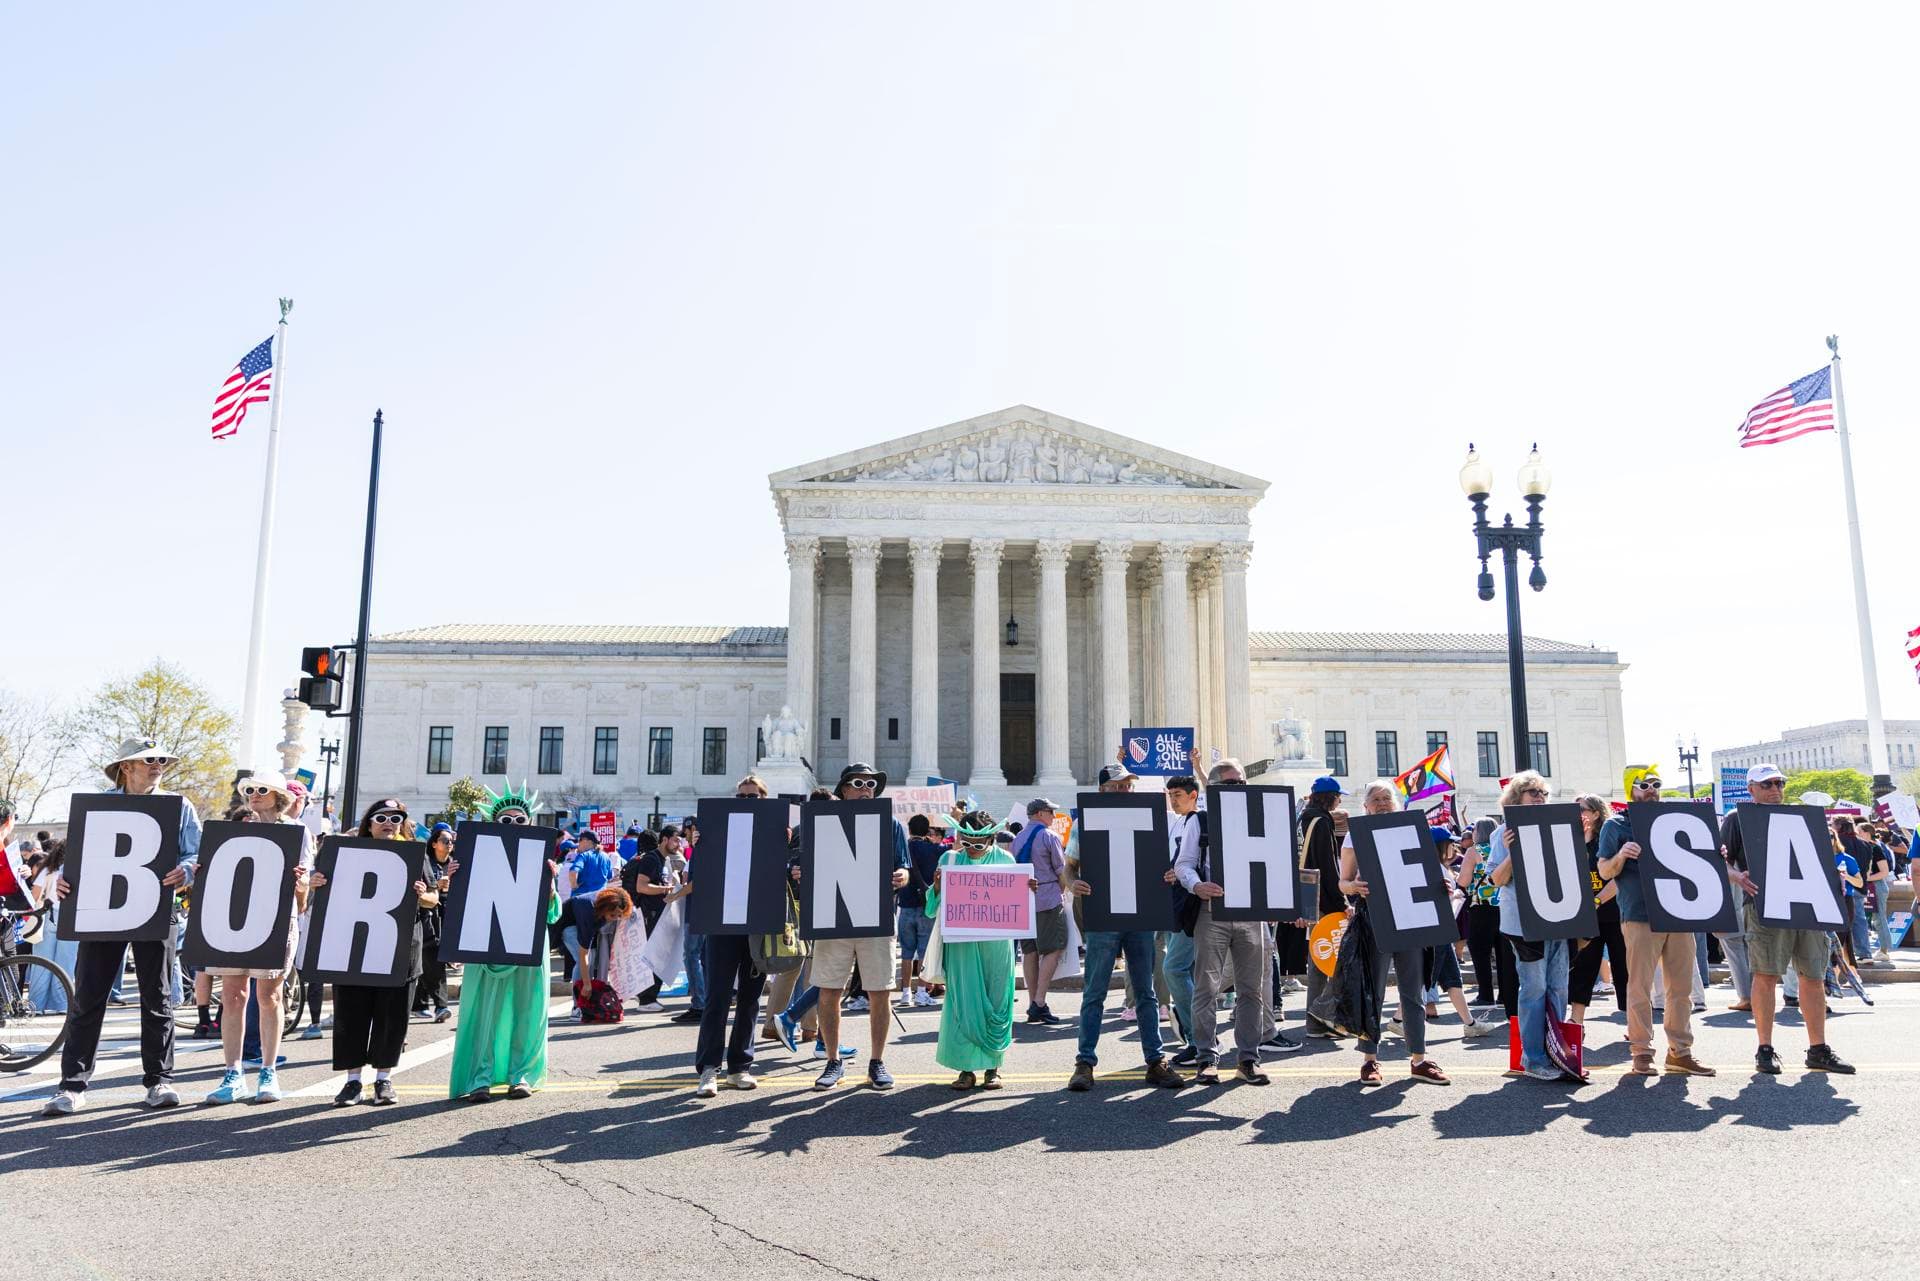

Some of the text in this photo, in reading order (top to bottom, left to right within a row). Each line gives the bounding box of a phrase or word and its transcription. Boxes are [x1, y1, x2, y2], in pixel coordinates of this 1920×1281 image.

[1155, 733, 1177, 743] ALL
[1155, 742, 1182, 752] ONE
[1161, 751, 1188, 761] ONE
[1163, 761, 1185, 770] ALL
[75, 811, 162, 932] B
[201, 837, 284, 952] O
[459, 835, 546, 954] N
[723, 813, 753, 924] I
[813, 814, 880, 928] N
[949, 873, 1015, 888] CITIZENSHIP
[969, 890, 990, 900] IS A
[1084, 807, 1153, 914] T
[1220, 791, 1294, 909] H
[1372, 825, 1439, 930] E
[1518, 824, 1581, 922] U
[1650, 813, 1723, 919] S
[1764, 813, 1843, 924] A
[317, 847, 407, 974] R
[946, 903, 1021, 923] BIRTHRIGHT
